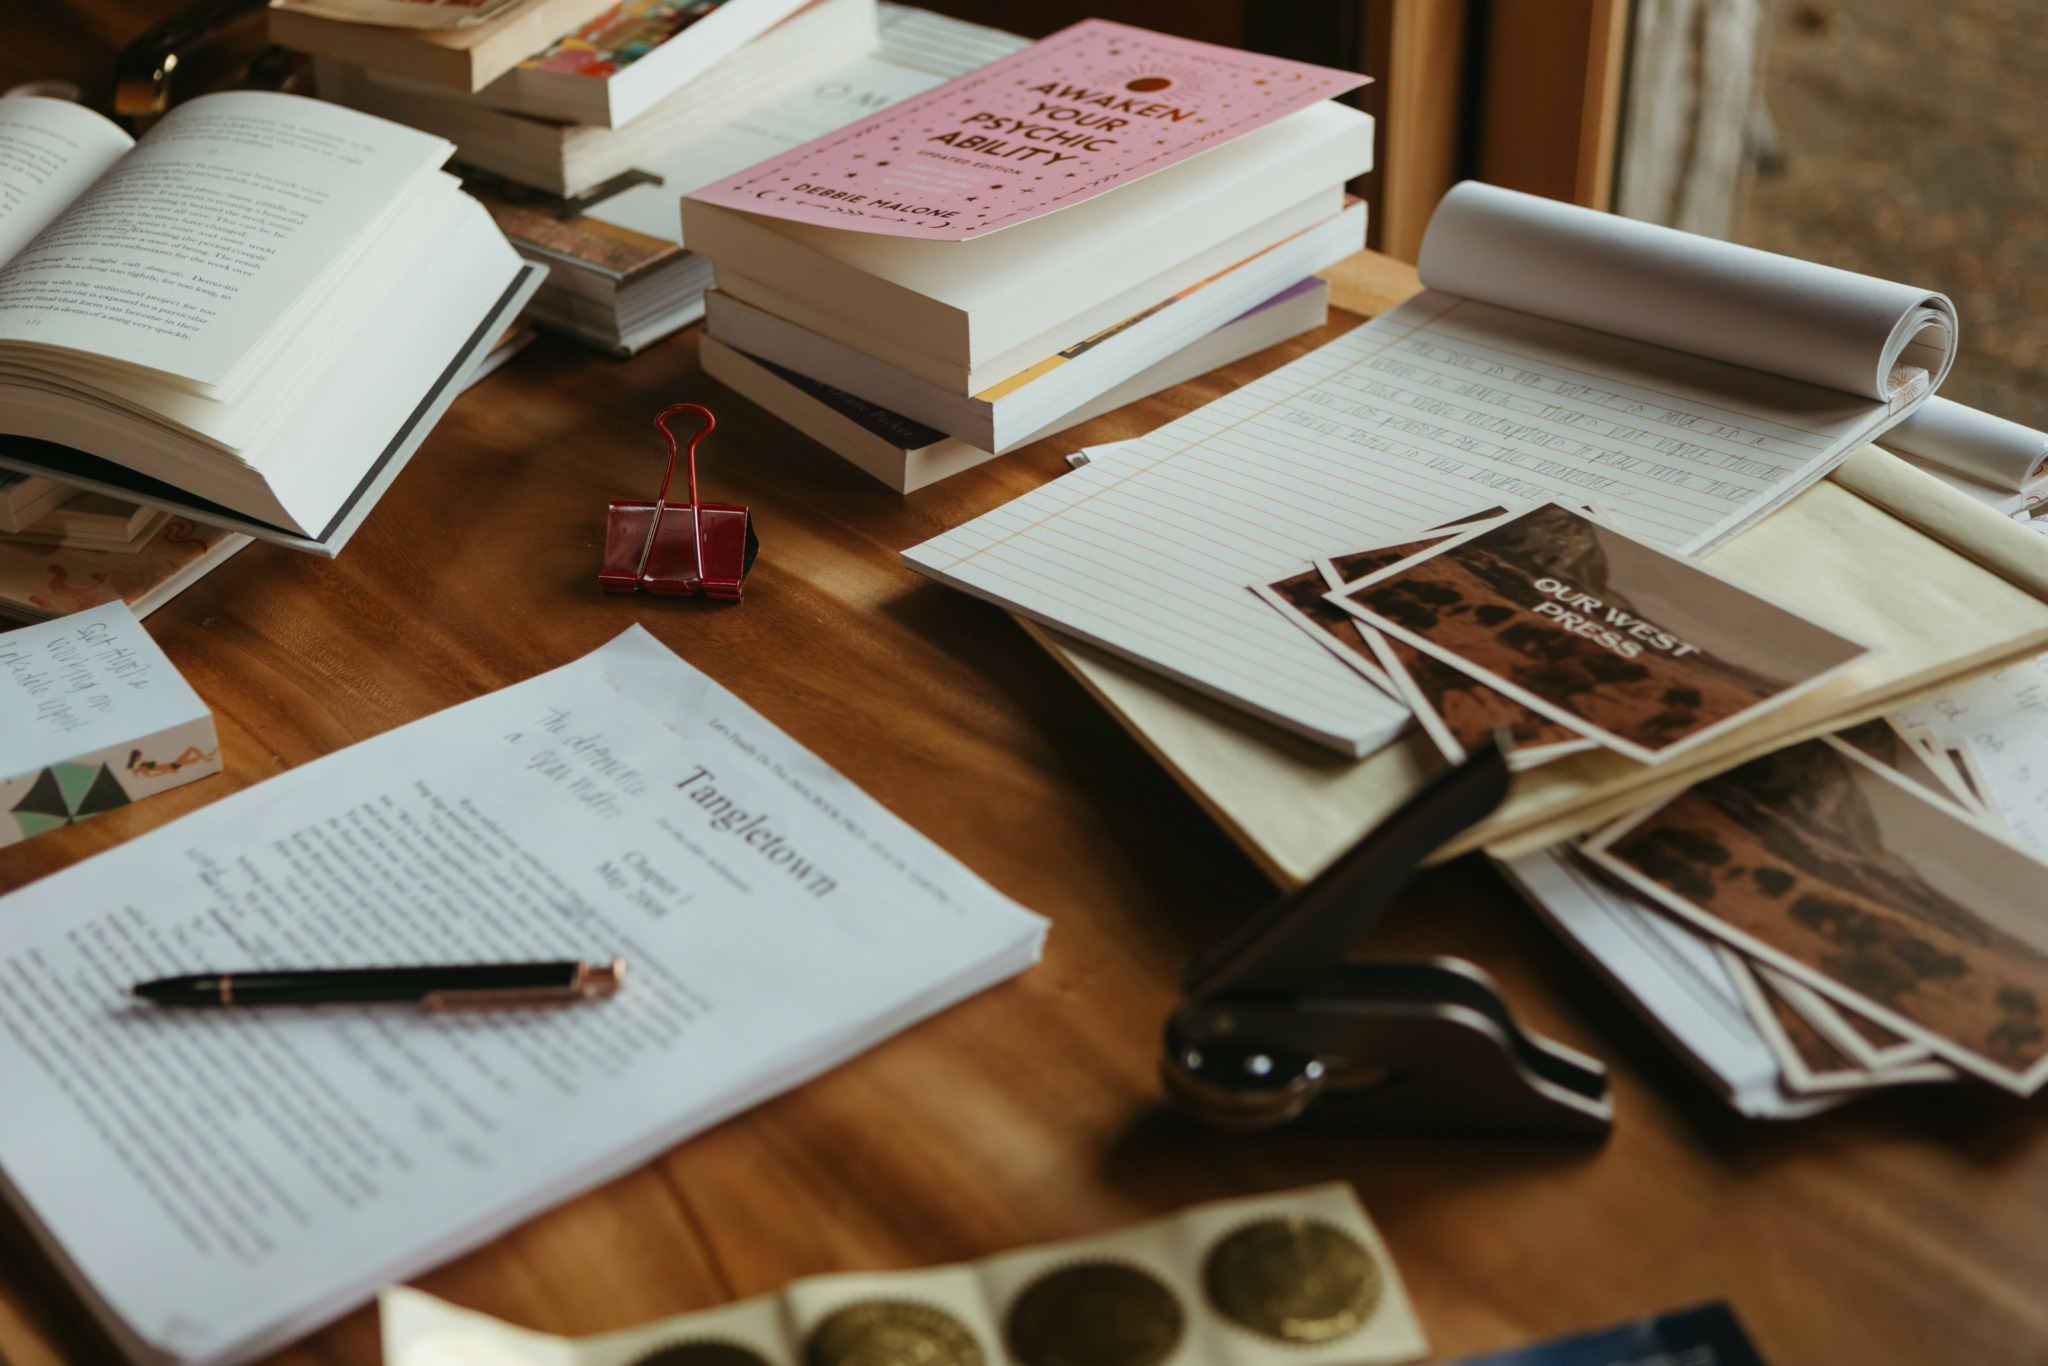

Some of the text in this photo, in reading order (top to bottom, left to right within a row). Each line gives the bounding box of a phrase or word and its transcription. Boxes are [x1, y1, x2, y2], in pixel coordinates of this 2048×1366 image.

[1026, 81, 1198, 123] AWAKEN
[1029, 102, 1130, 132] YOUR
[927, 131, 1080, 166] ABILITY
[960, 111, 1119, 152] PSYCHIC
[917, 150, 1024, 175] UPDATED EDITION
[793, 183, 961, 219] DEBBIE MALONE
[76, 622, 118, 649] Get
[1531, 601, 1645, 659] PRESS
[1533, 577, 1701, 658] OUR WEST
[46, 637, 100, 694] working
[533, 705, 571, 734] The
[502, 731, 524, 745] a
[676, 764, 839, 899] Tangletown
[595, 860, 628, 890] May
[621, 850, 681, 897] Chapter
